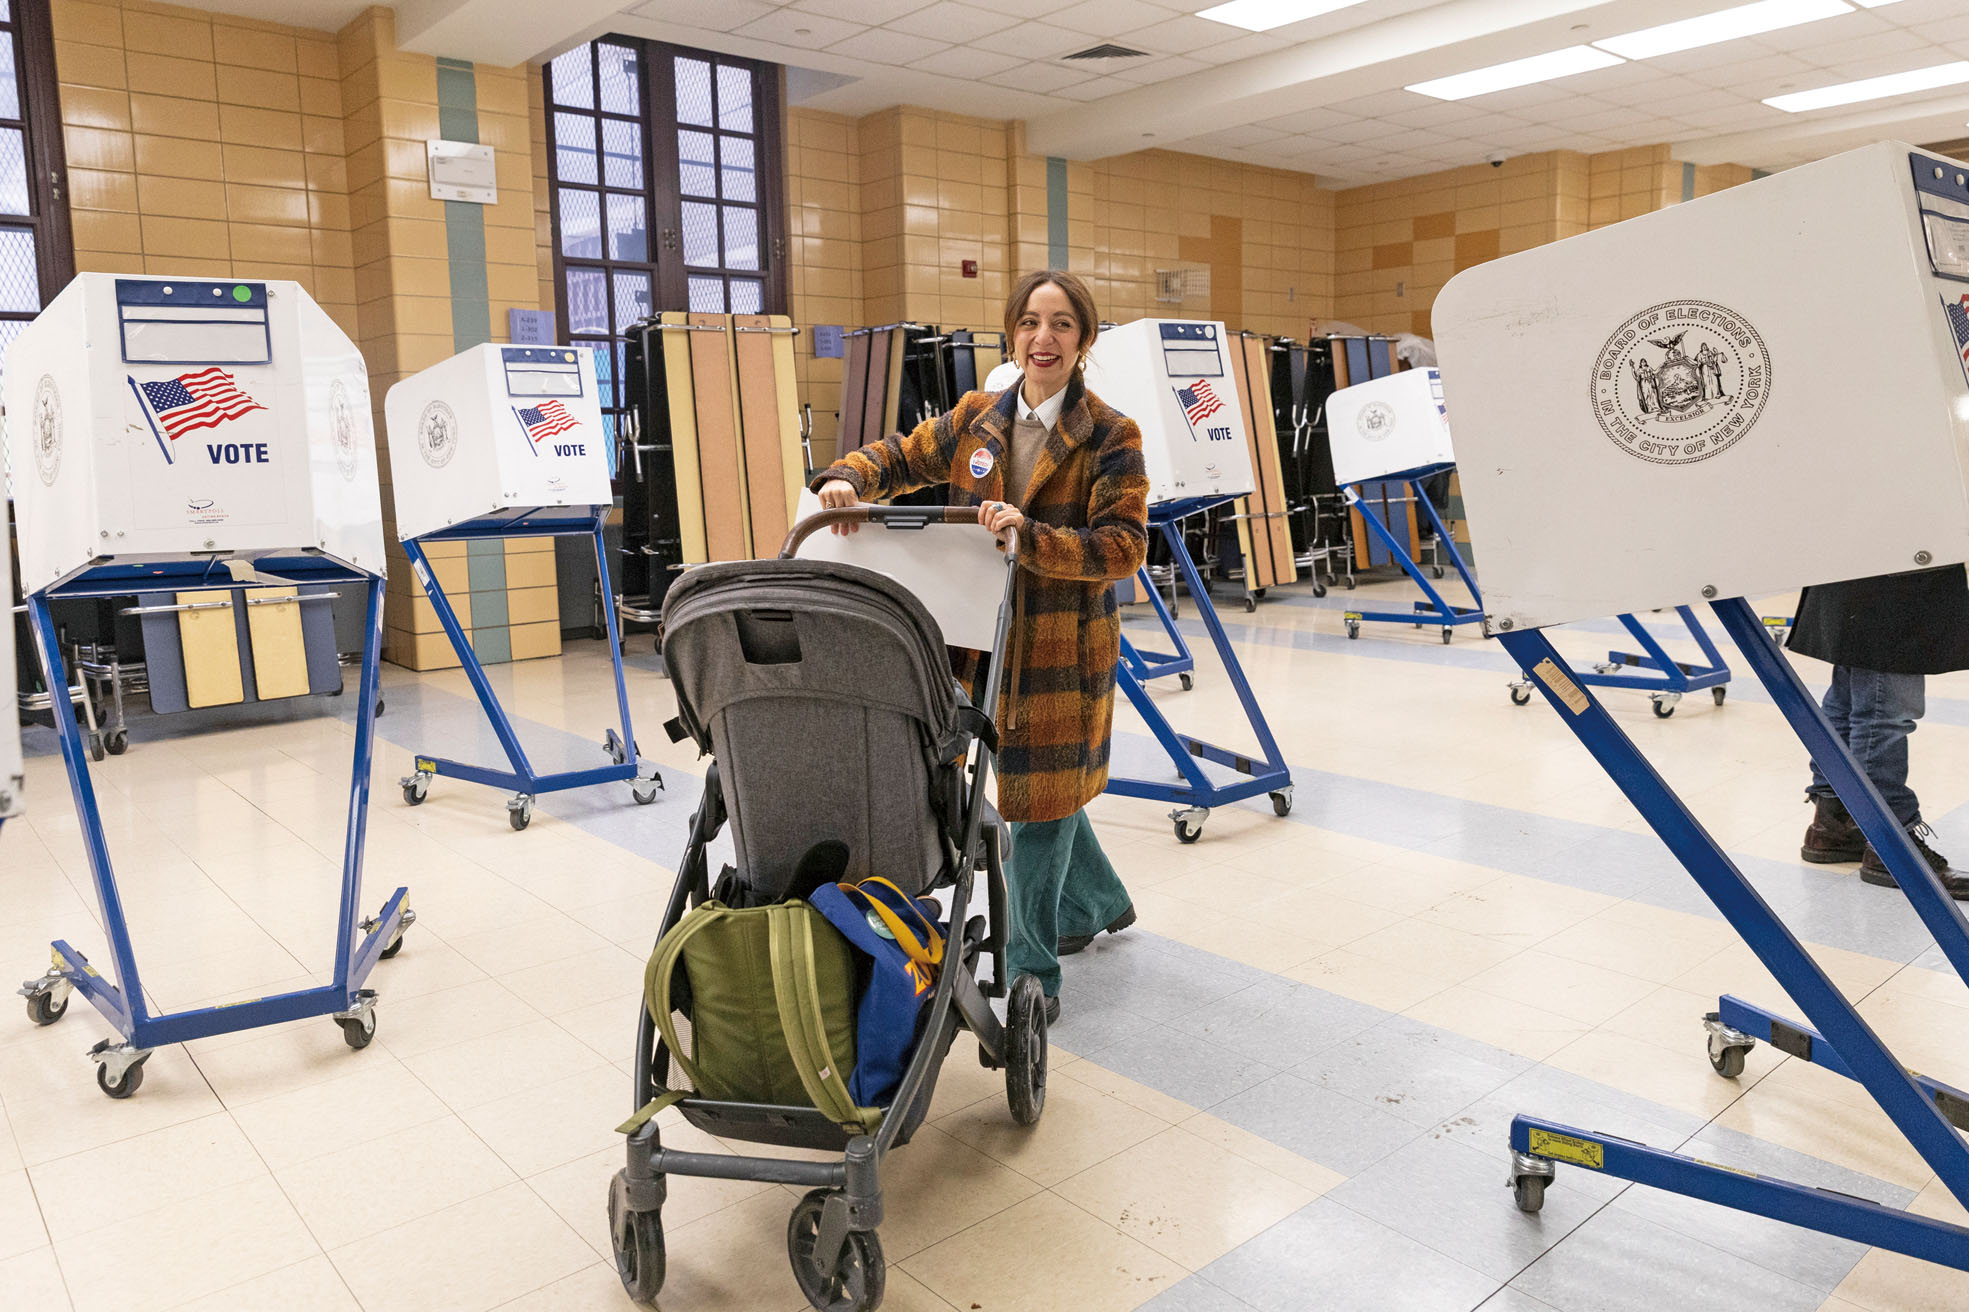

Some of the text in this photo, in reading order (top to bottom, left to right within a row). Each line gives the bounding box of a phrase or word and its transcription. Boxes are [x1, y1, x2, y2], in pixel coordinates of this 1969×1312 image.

[1600, 308, 1751, 380] BOARD OF ELECTIONS
[1601, 365, 1761, 456] IN THE CITY OF NEW YORK
[1665, 408, 1705, 422] EXCELSIOR
[1207, 427, 1232, 441] VOTE
[206, 443, 269, 464] VOTE
[554, 444, 586, 457] VOTE
